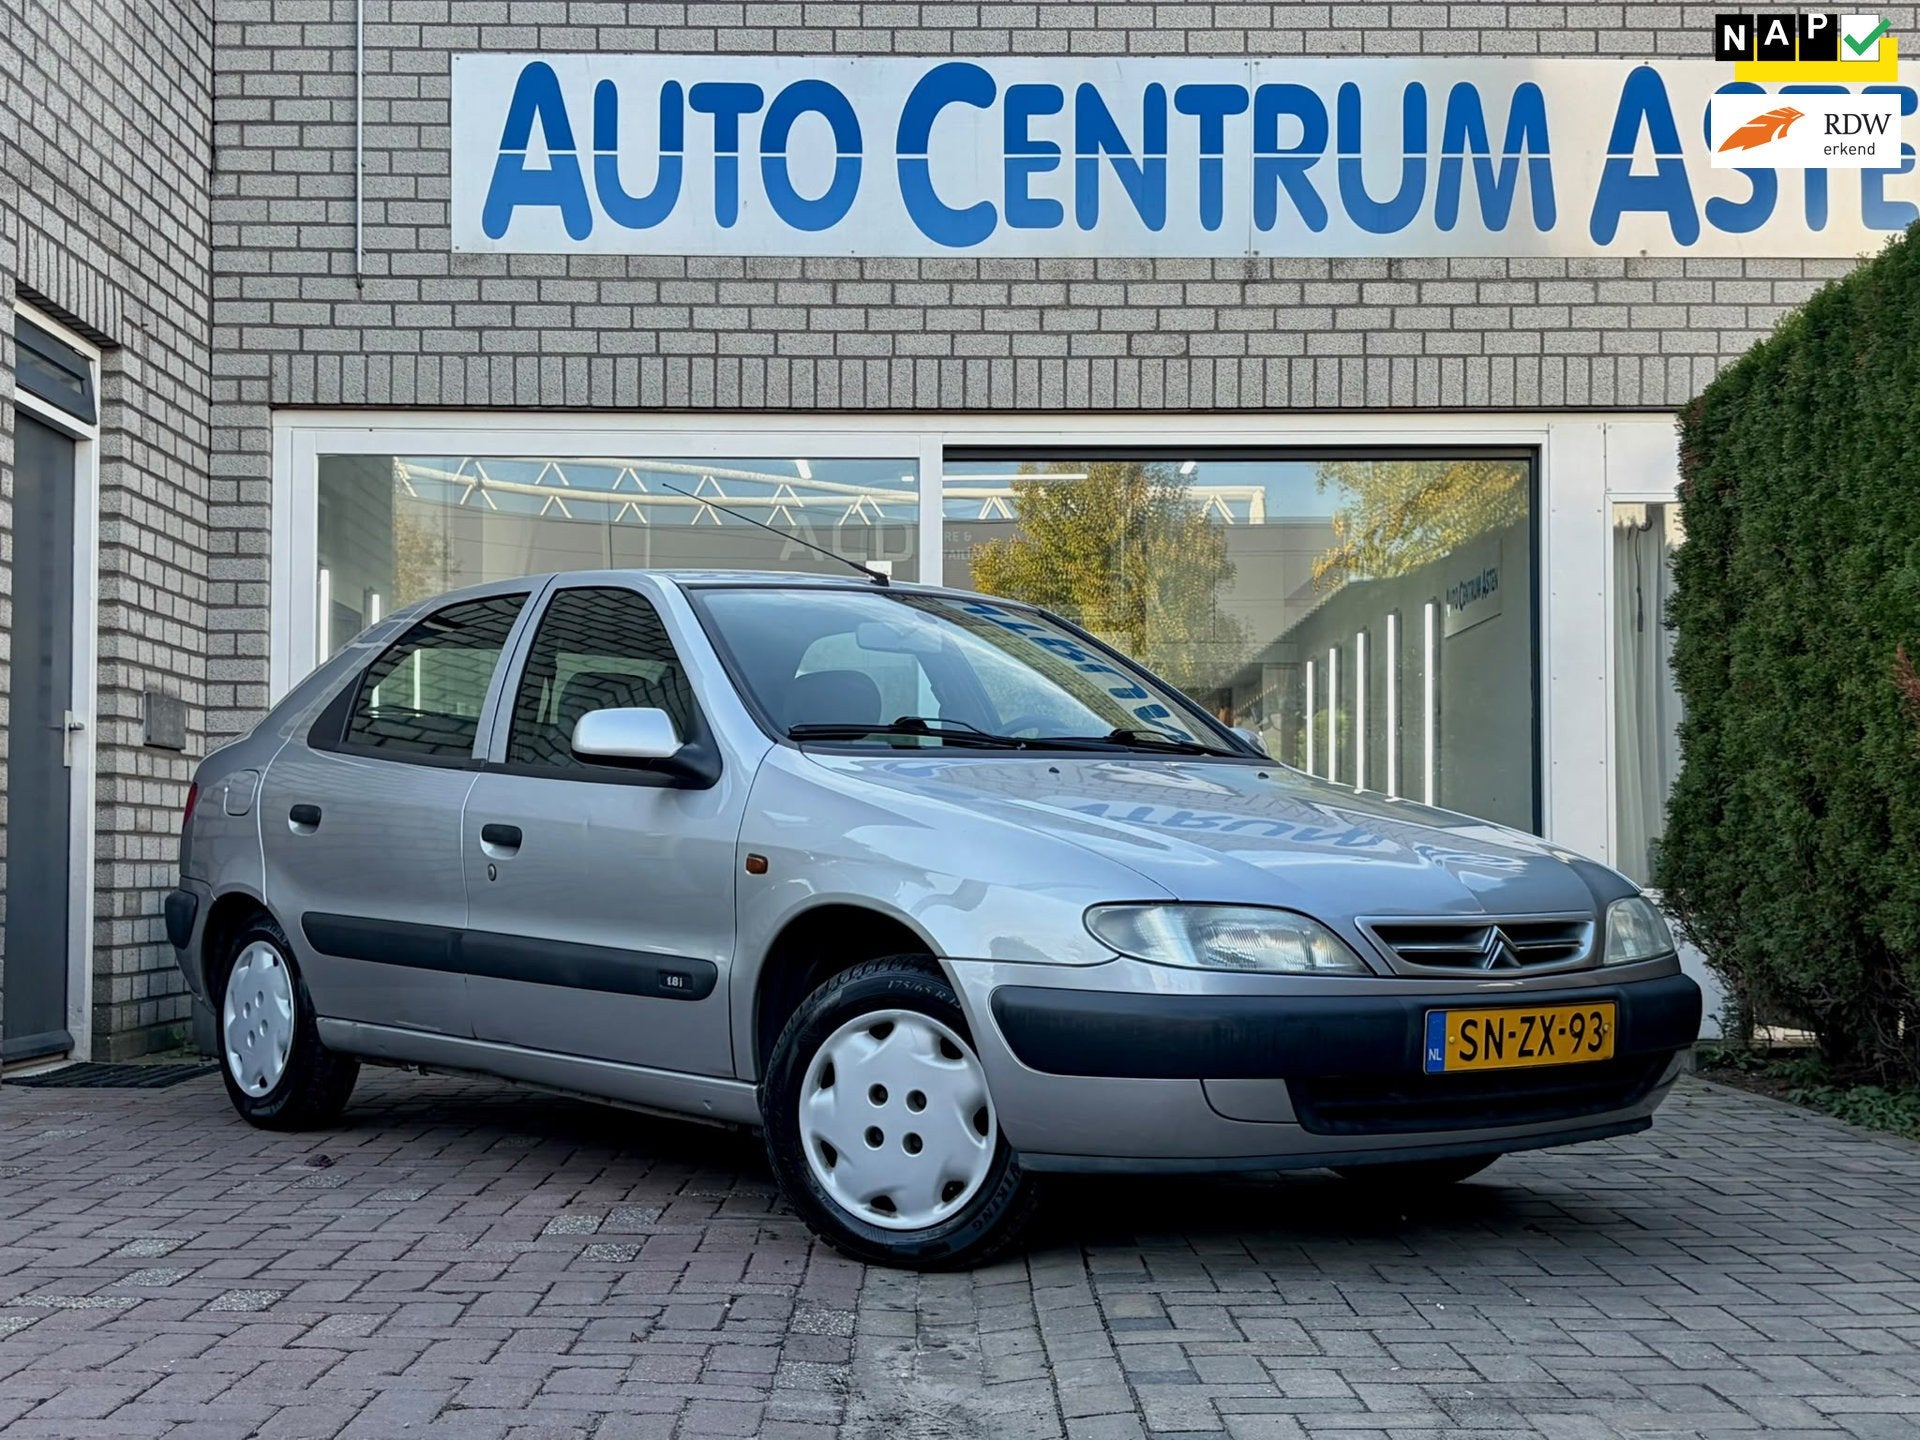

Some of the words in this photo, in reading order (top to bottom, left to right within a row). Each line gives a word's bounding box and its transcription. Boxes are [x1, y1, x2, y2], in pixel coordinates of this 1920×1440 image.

[482, 61, 864, 241] AUTO
[895, 61, 1557, 248] CENTRUM
[1428, 1048, 1442, 1061] NL
[1459, 1011, 1604, 1062] SN-ZX-93
